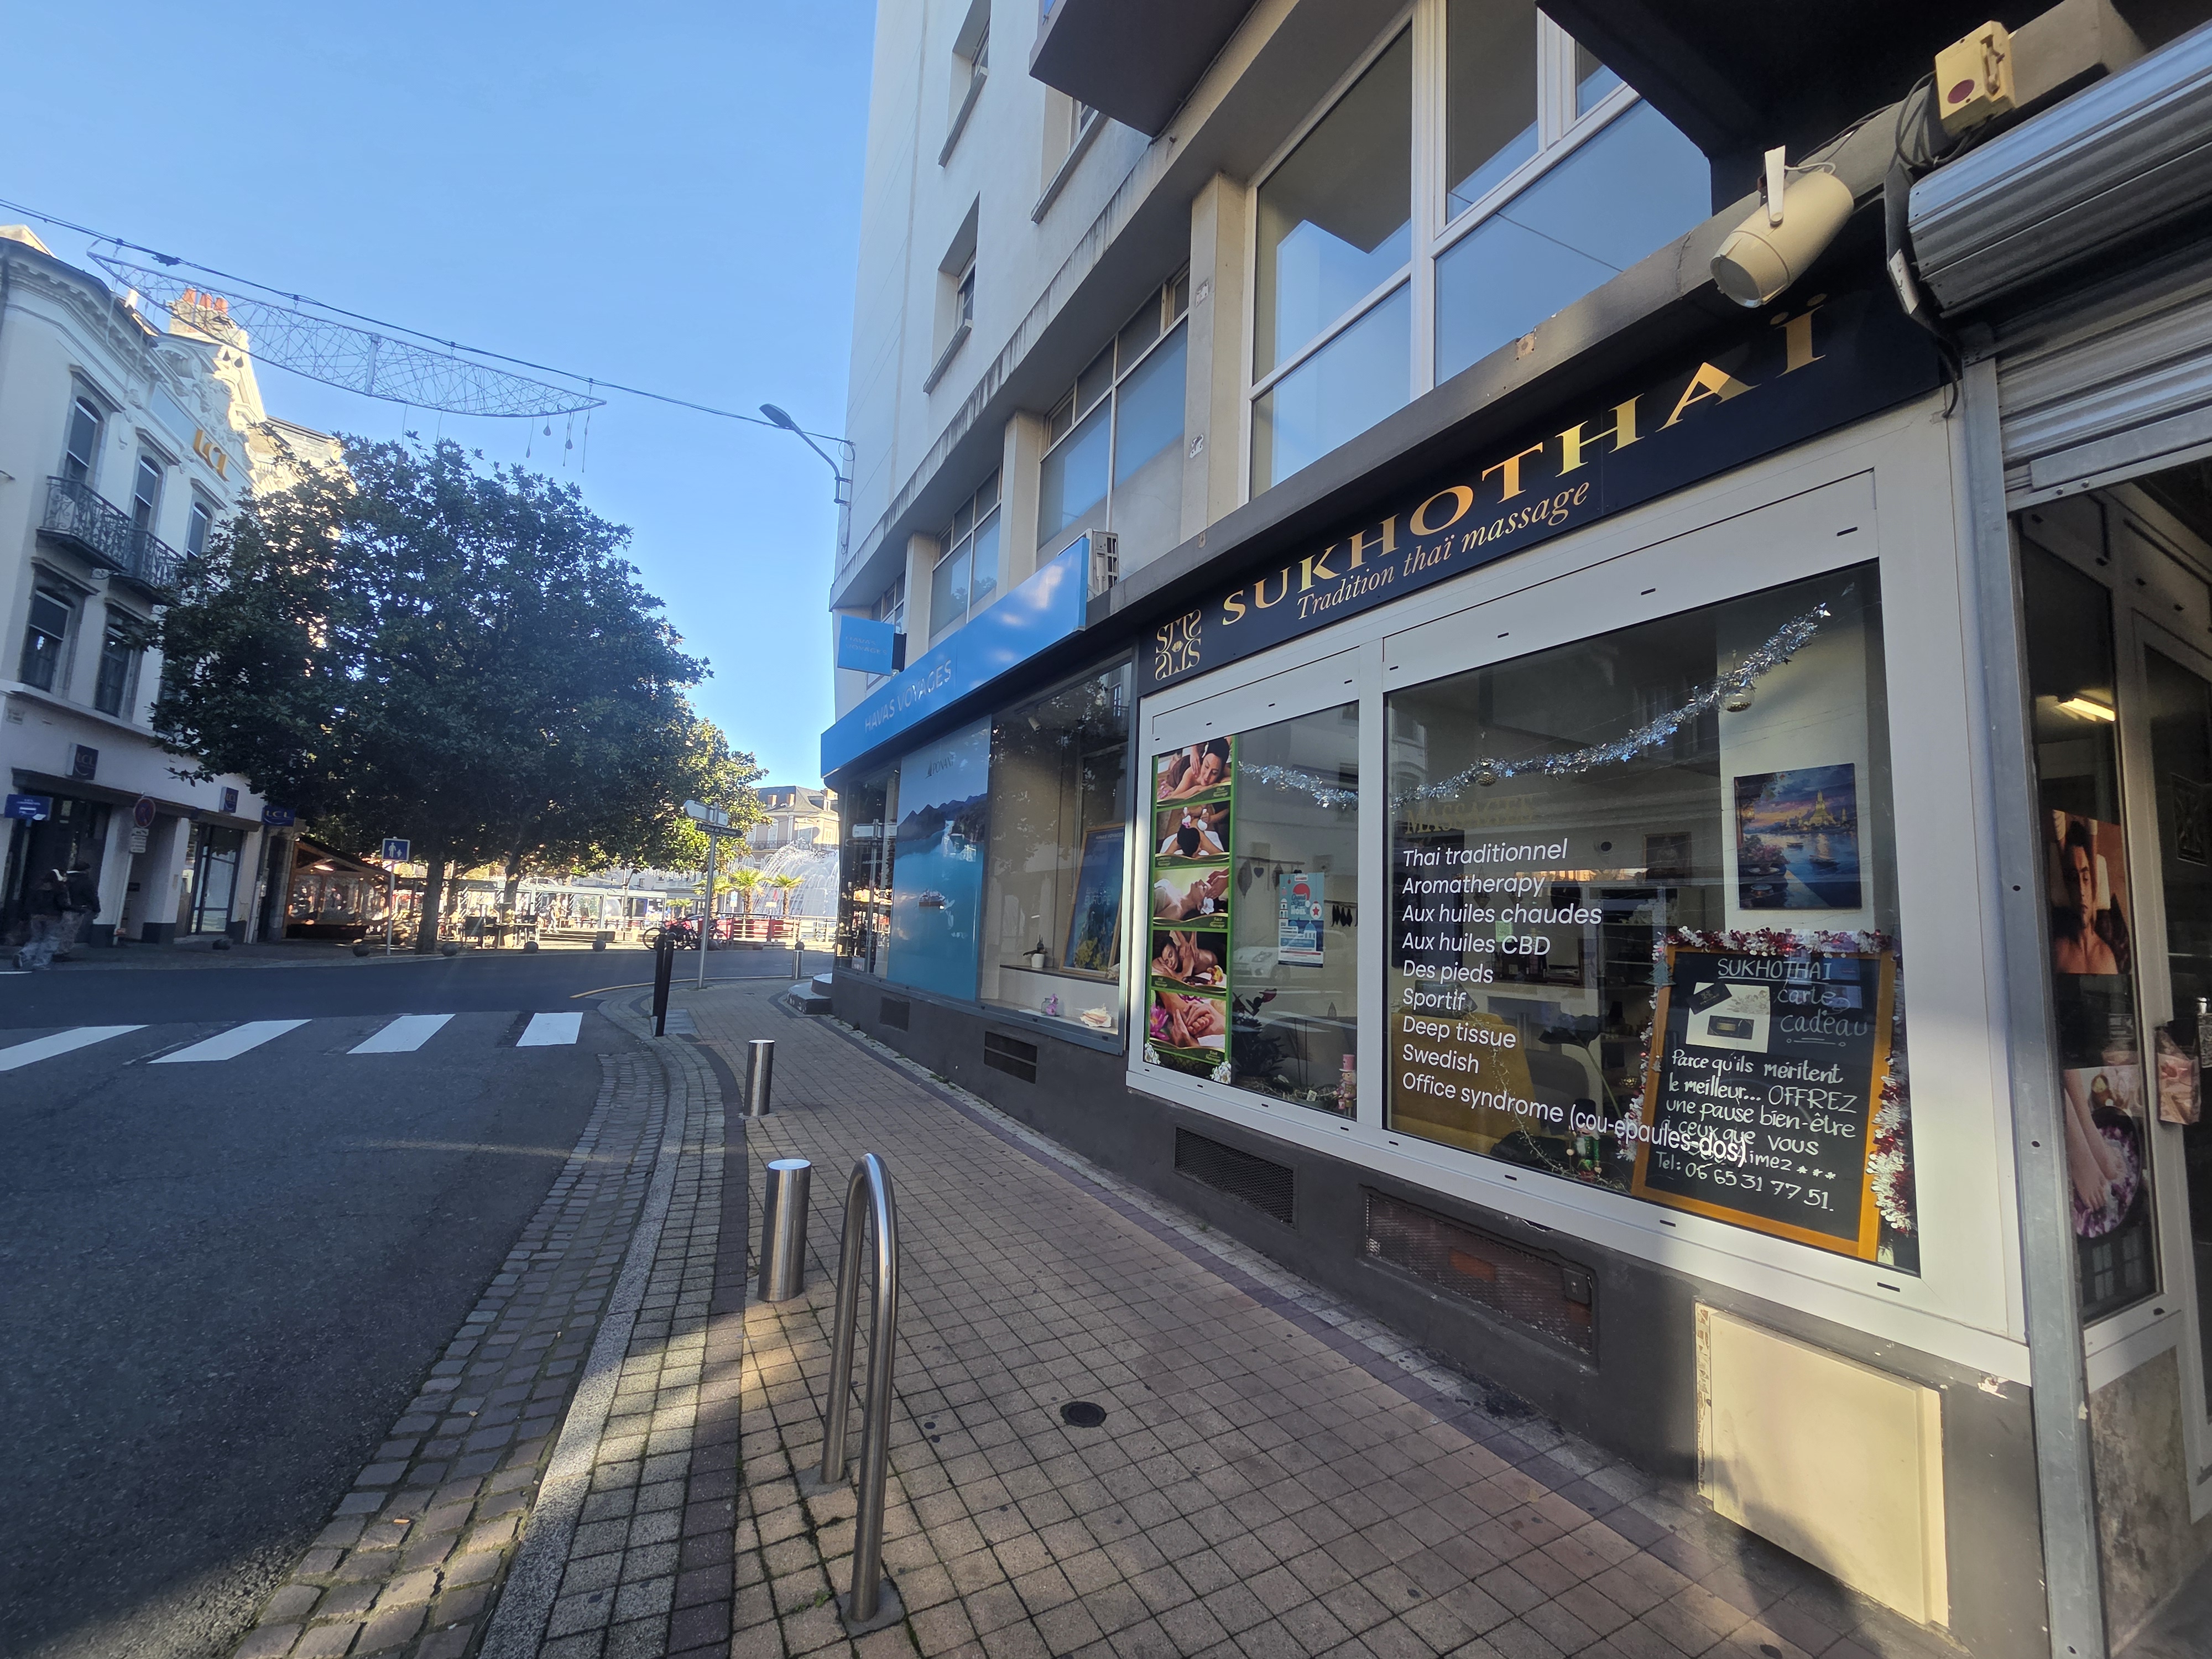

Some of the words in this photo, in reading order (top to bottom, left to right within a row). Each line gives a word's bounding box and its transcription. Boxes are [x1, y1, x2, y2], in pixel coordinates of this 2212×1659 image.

[193, 430, 230, 482] LCL
[1297, 565, 1394, 620] Tradition
[1403, 534, 1457, 577] thaï
[1461, 482, 1590, 553] massage
[845, 636, 877, 646] HAVAS
[845, 643, 888, 655] VOYAGES
[864, 698, 895, 734] HAVAS
[897, 659, 952, 712] VOYAGES
[76, 752, 94, 766] LCL
[227, 793, 236, 802] LCL
[1403, 847, 1441, 867] Thai
[1446, 838, 1568, 865] traditionnel
[1402, 874, 1546, 898] Aromatherapy
[1402, 905, 1436, 922] Aux
[1439, 904, 1495, 922] huiles
[1501, 902, 1602, 925] chaudes
[1402, 932, 1436, 951] Aux
[1439, 932, 1495, 953] huiles
[1501, 935, 1551, 956] CBD
[1403, 959, 1436, 979] Des
[1440, 962, 1494, 984] pieds
[1402, 987, 1467, 1011] Sportif
[1777, 988, 1838, 1006] carte
[1403, 1015, 1451, 1042] Deep
[1455, 1021, 1516, 1048] tissue
[1780, 1008, 1868, 1037] cadeau
[1402, 1044, 1479, 1074] Swedish
[1672, 1049, 1709, 1068] Parce
[1764, 1060, 1844, 1084] méritent
[1669, 1072, 1679, 1092] le
[1768, 1085, 1858, 1114] OFFREZ
[1402, 1072, 1456, 1099] Office
[1460, 1090, 1564, 1123] syndrome
[1570, 1104, 1746, 1168] (cou-epaules-dos)
[1666, 1099, 1696, 1114] une
[1699, 1103, 1754, 1122] pause
[1760, 1105, 1856, 1138] bien-être
[1678, 1120, 1719, 1140] ceux
[1722, 1128, 1756, 1146] que
[1656, 1151, 1681, 1171] Tel:
[1685, 1162, 1709, 1180] 06
[1714, 1168, 1738, 1186] 65
[1740, 1174, 1763, 1192] 31
[1770, 1180, 1802, 1199] 77
